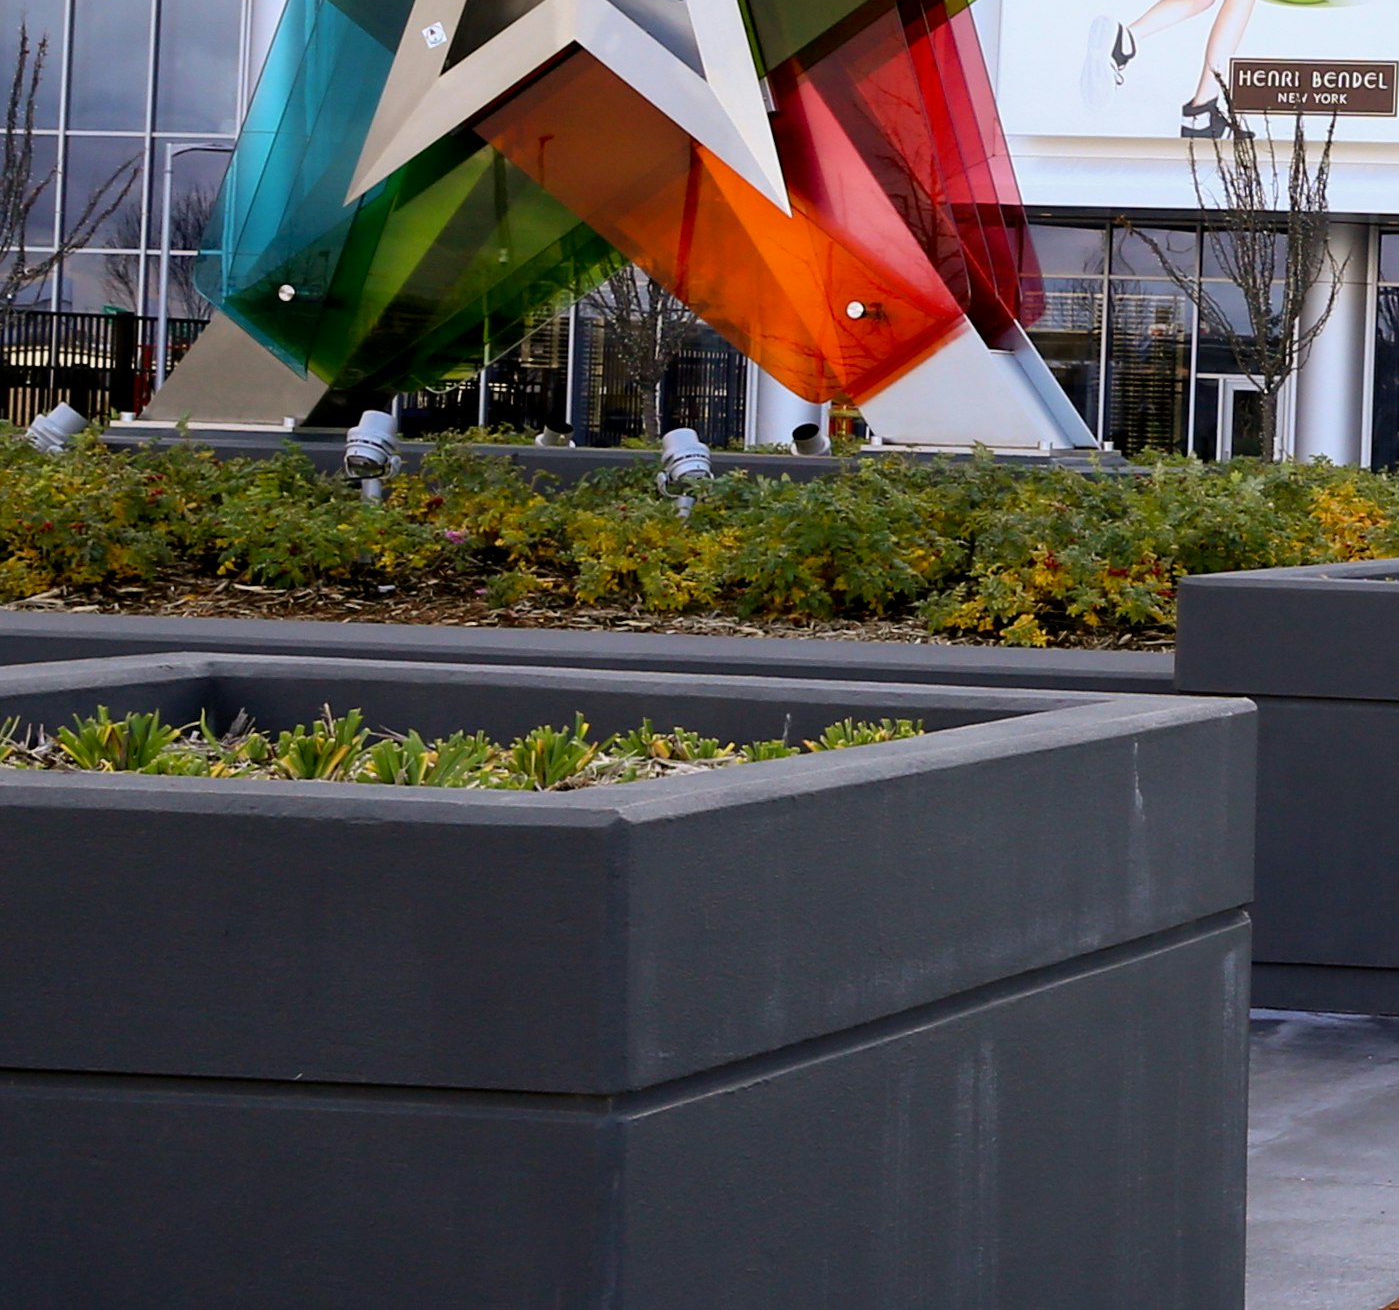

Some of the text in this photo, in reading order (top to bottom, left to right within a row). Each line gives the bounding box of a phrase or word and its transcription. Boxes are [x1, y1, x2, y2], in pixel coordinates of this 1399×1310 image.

[1238, 69, 1388, 90] HENRI BENDEL
[1313, 92, 1348, 105] YORK
